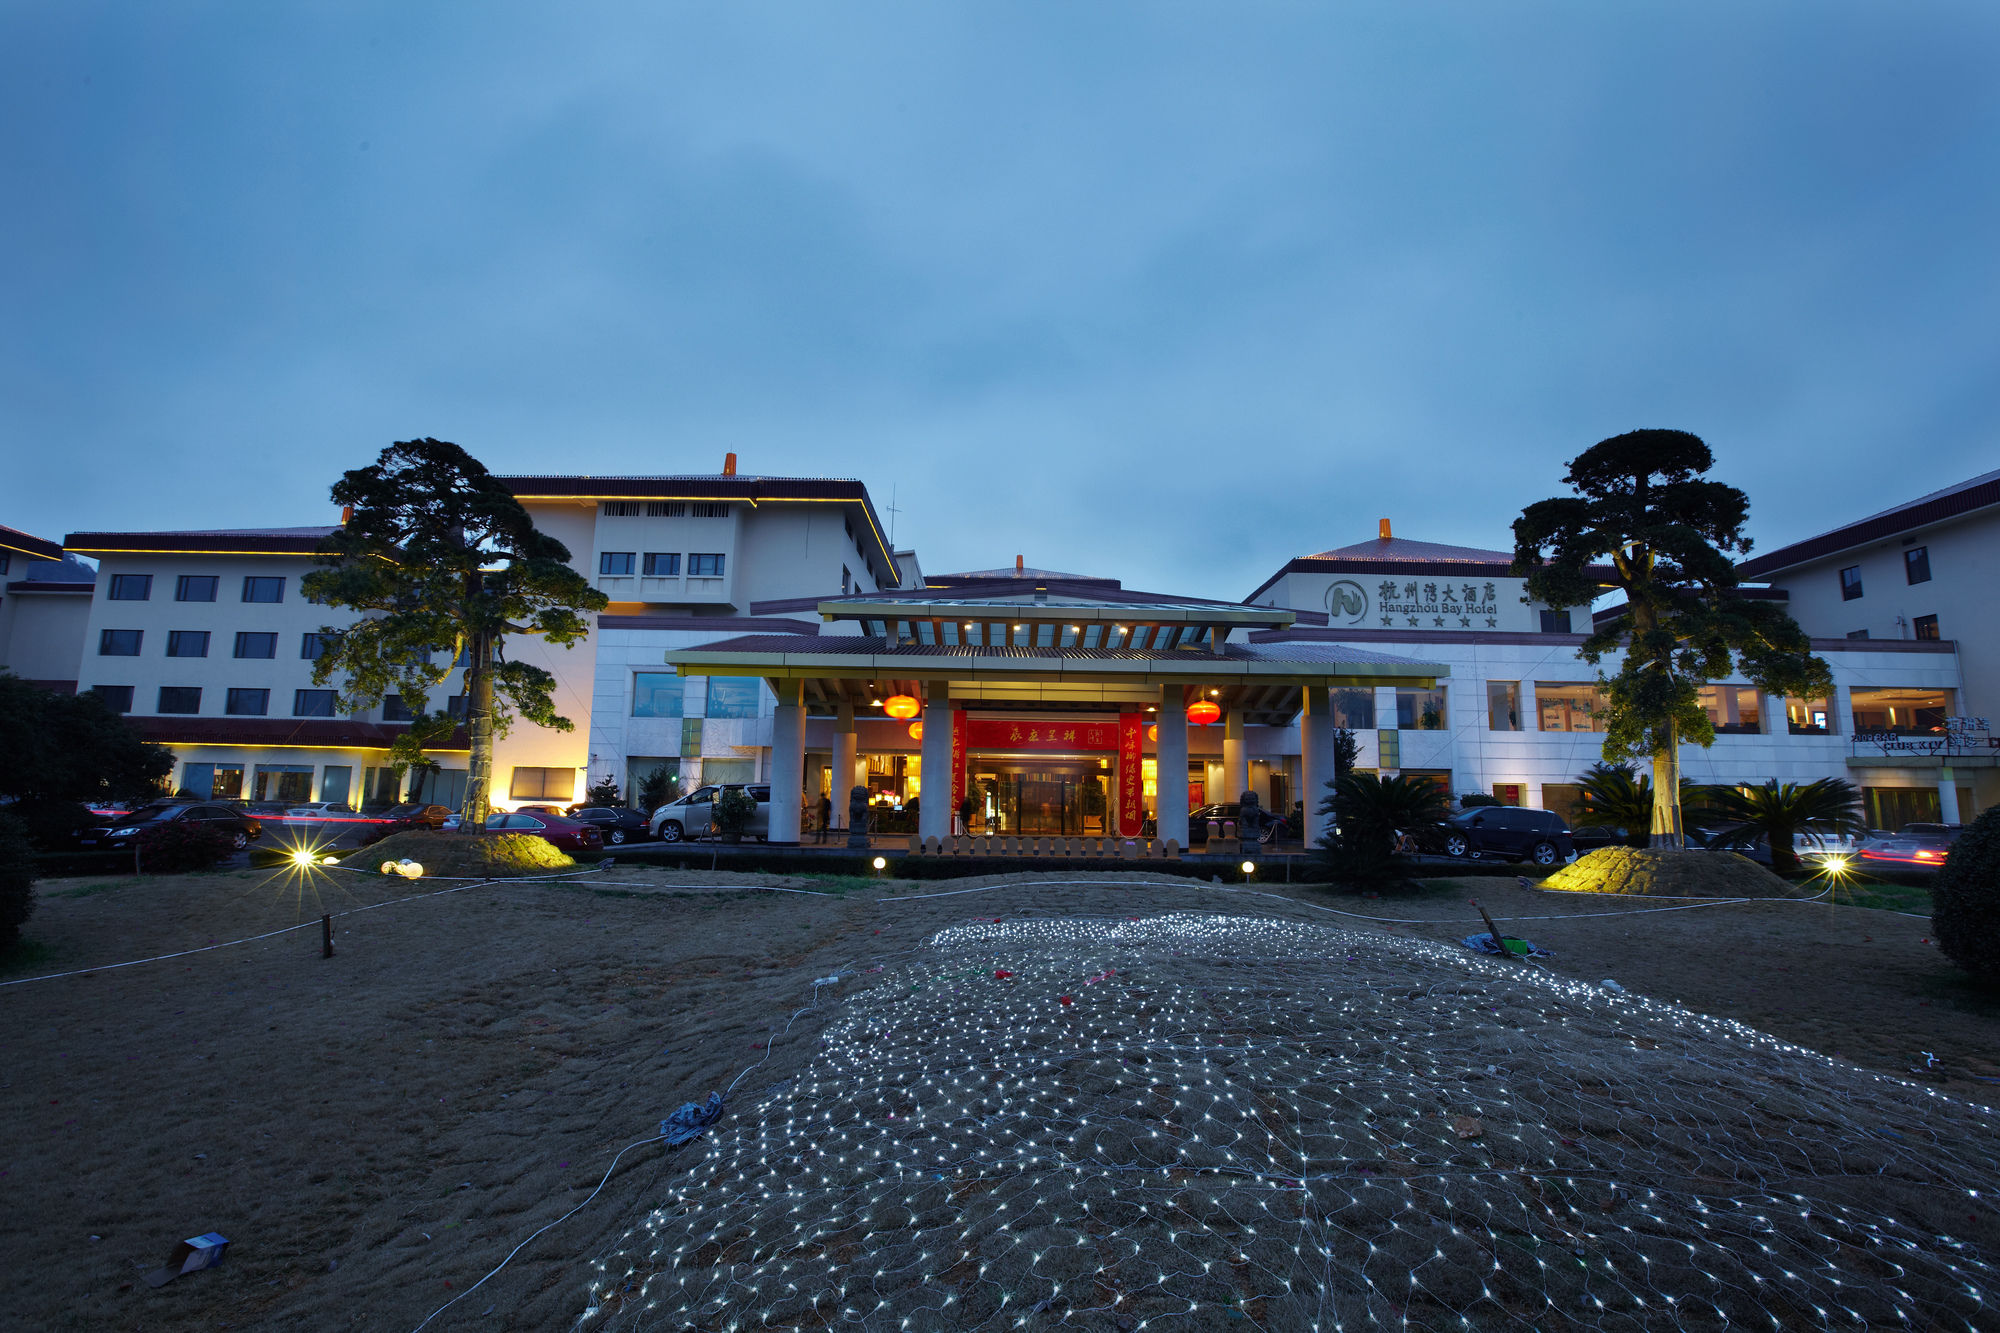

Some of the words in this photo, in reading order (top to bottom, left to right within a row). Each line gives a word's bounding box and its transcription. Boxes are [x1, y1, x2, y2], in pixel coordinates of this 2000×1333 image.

[1379, 580, 1497, 604] 杭州湾大酒店
[1380, 602, 1438, 615] Hangzhou
[1442, 603, 1462, 616] Bay
[1466, 603, 1497, 614] Hotel
[1884, 742, 1913, 750] CLUB
[1919, 741, 1942, 750] KTV
